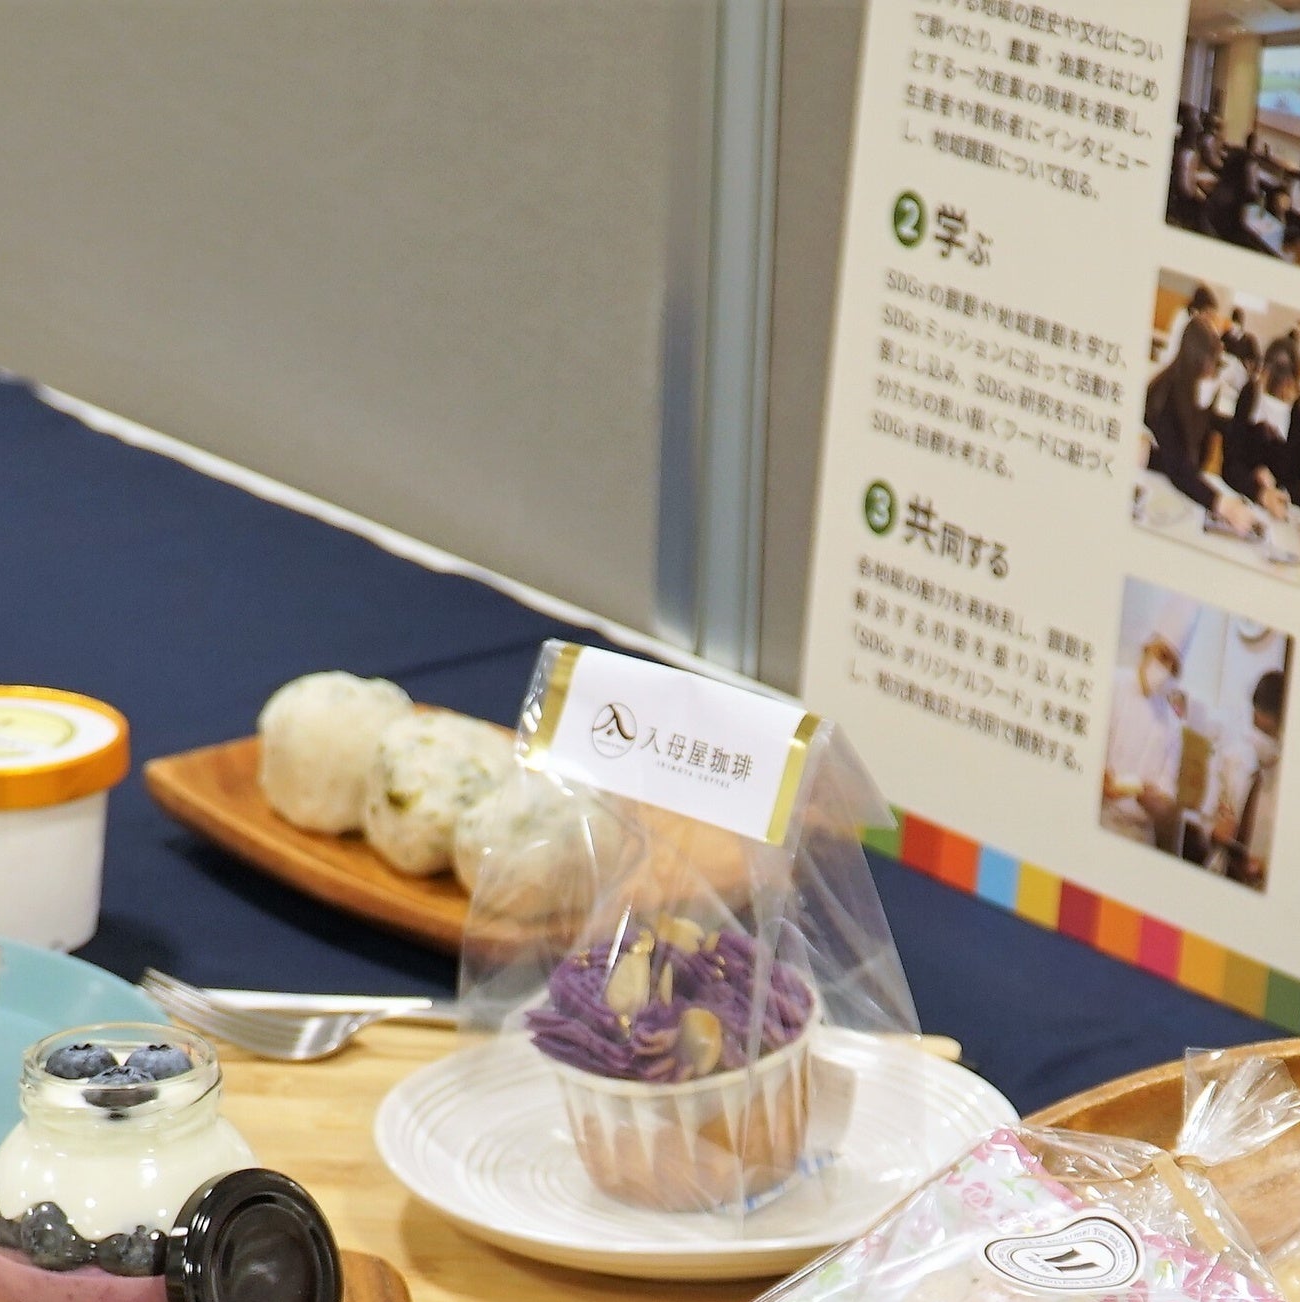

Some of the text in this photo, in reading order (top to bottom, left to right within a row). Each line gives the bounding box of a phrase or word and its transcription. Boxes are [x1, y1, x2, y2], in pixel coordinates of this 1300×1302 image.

[934, 203, 994, 267] 学ぶ
[903, 495, 1010, 580] 共同する
[640, 726, 754, 783] 入母屋珈琲
